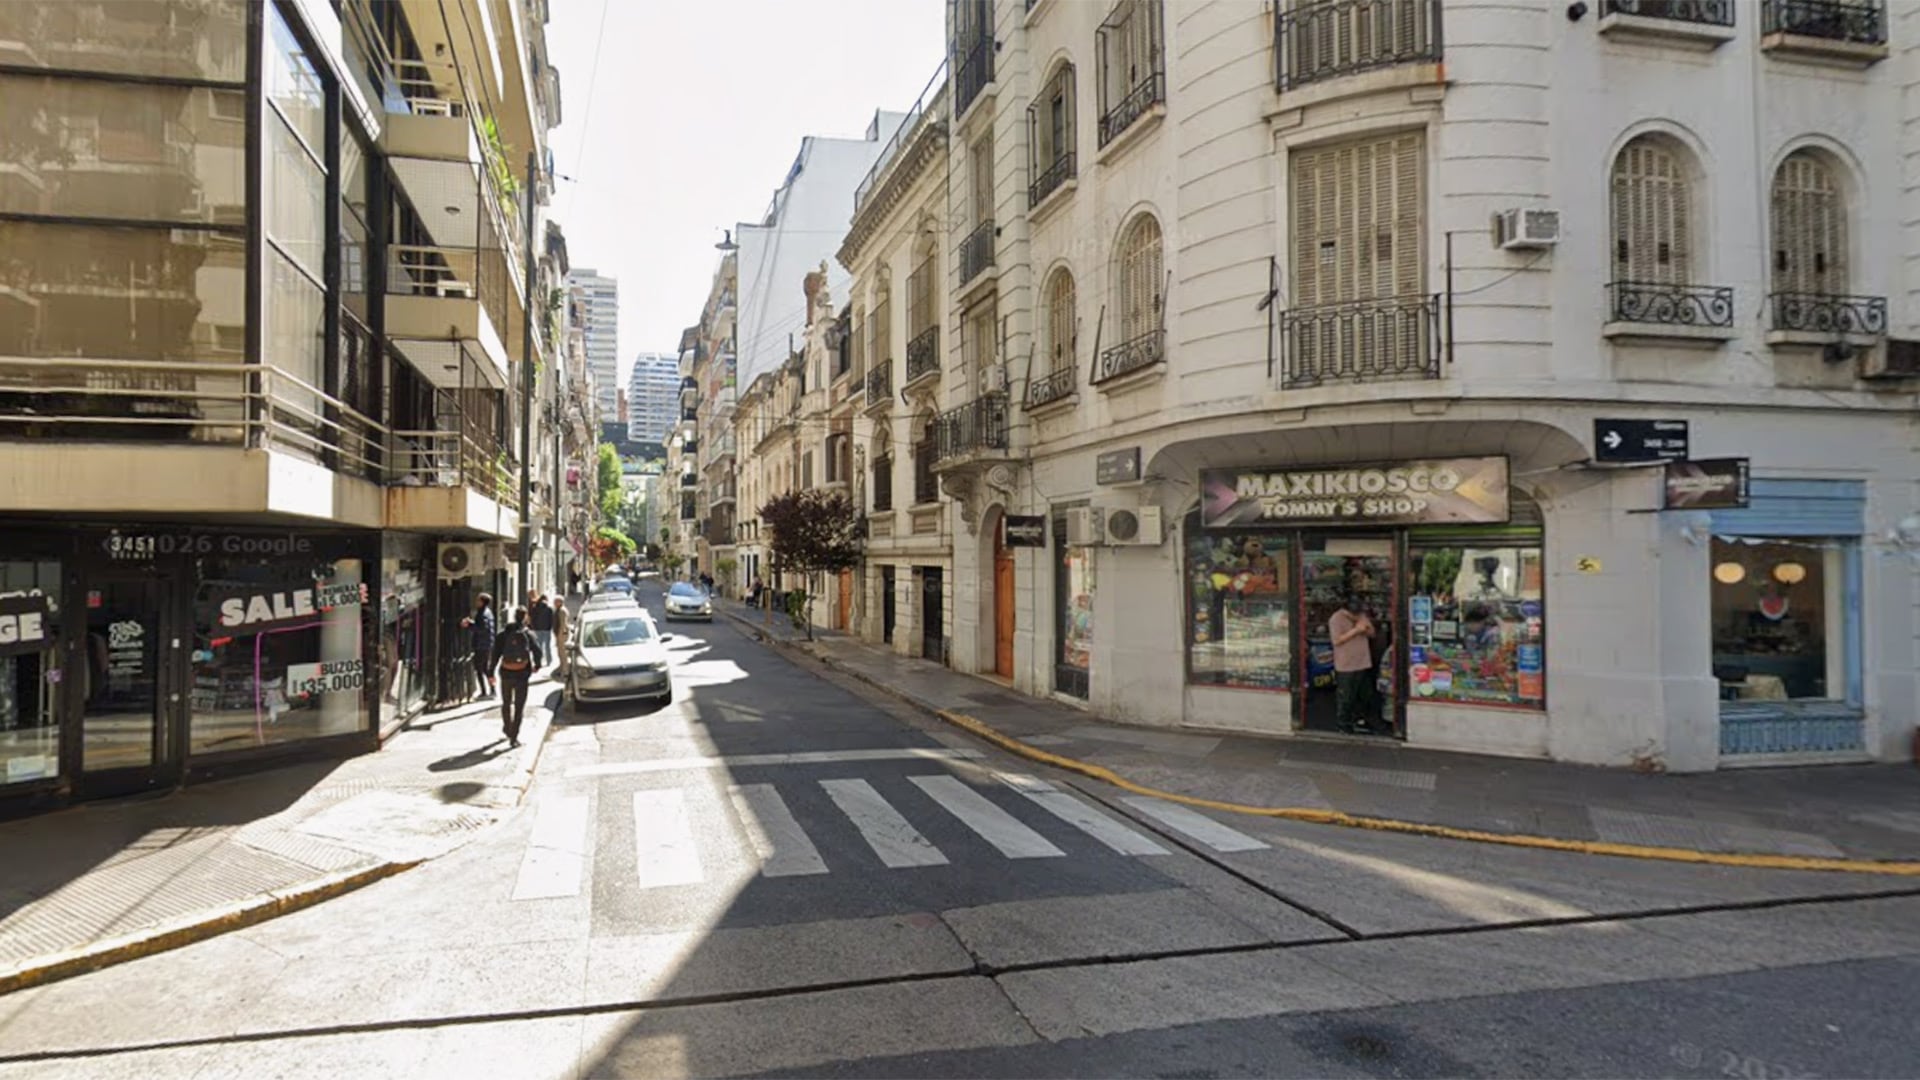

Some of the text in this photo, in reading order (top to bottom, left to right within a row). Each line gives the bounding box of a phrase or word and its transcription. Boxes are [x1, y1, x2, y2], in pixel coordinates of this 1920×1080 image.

[1237, 469, 1459, 497] MAXIKIOSCO
[1261, 498, 1426, 517] TOMMY'S SHOP
[111, 536, 155, 551] 3451
[220, 588, 314, 627] SALE
[321, 659, 362, 674] BUZOS
